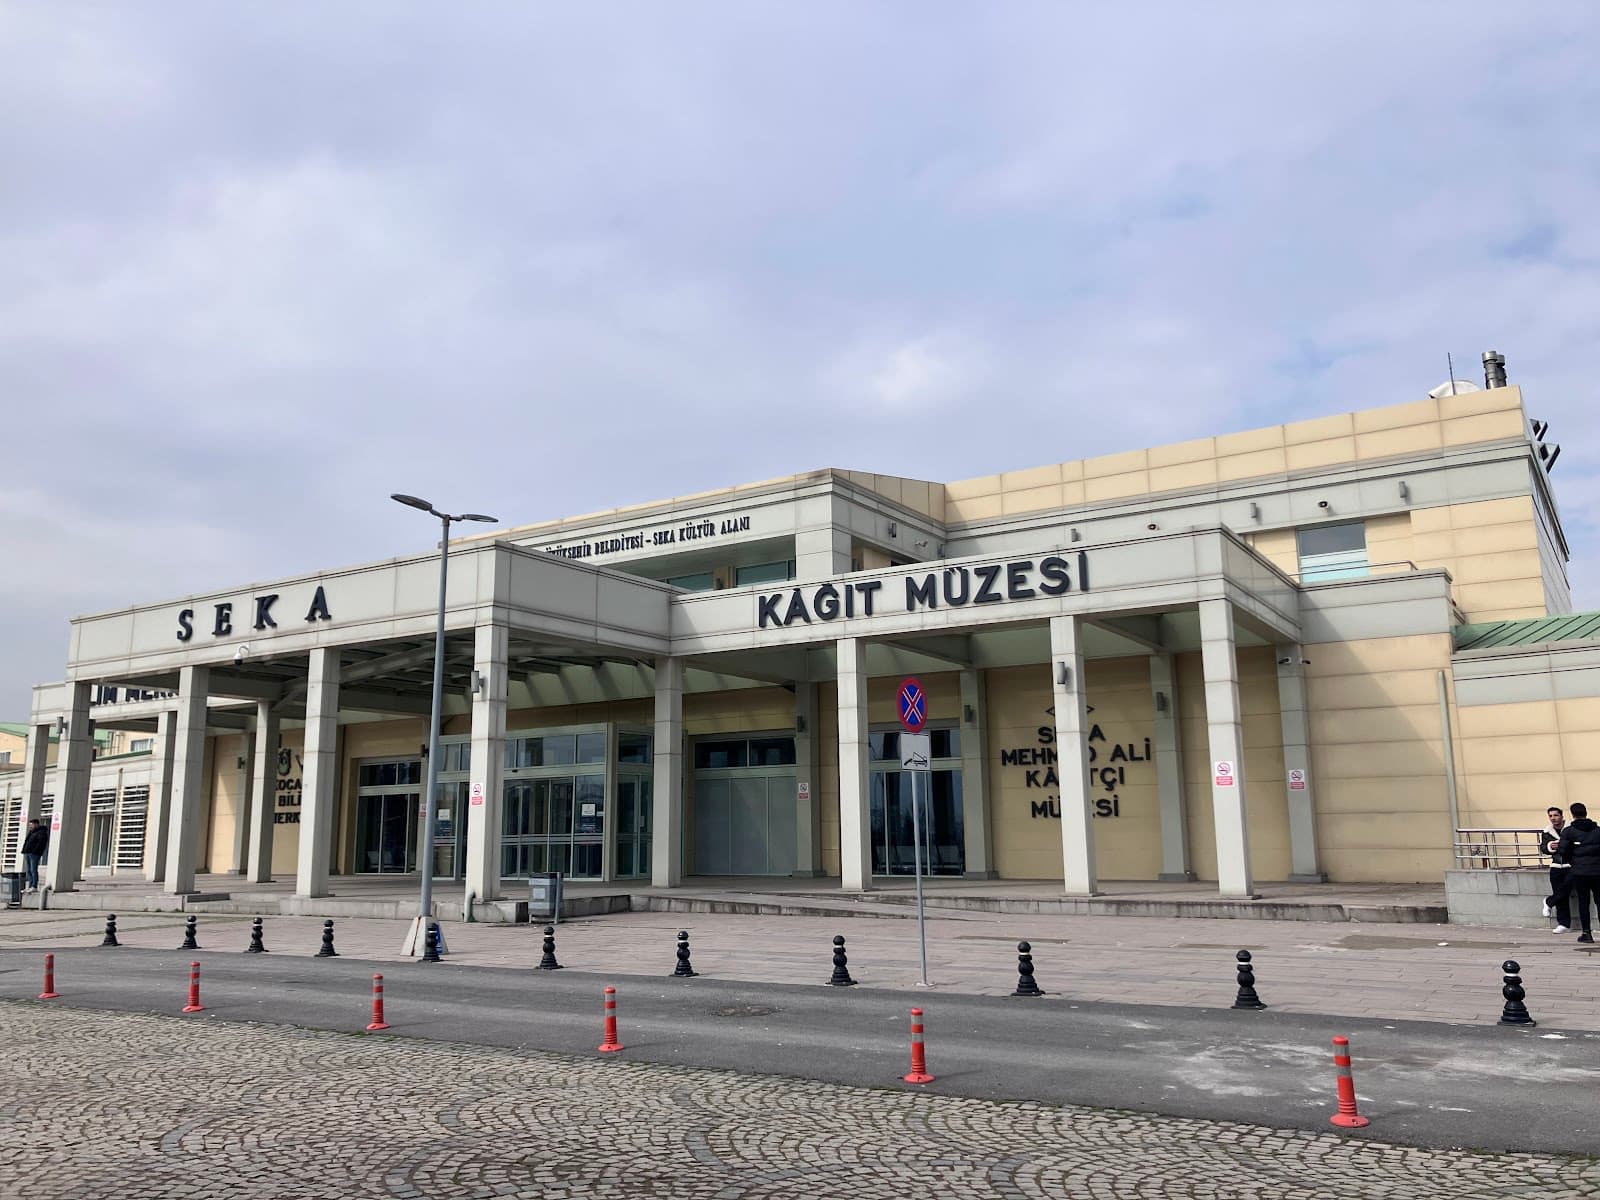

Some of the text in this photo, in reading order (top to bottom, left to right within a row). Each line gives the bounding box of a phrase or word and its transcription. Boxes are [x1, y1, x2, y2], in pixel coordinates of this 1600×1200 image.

[594, 532, 644, 555] BELEDİYESİ
[653, 530, 675, 546] SEKA
[679, 520, 716, 542] KÜLTÜR
[720, 516, 750, 535] ALANI
[905, 550, 1090, 612] MÜZESİ
[176, 585, 332, 641] SEKA
[1038, 724, 1106, 744] SA
[1110, 737, 1151, 762] ALİ
[1025, 766, 1125, 791] KÂTÇI
[1031, 794, 1119, 818] MÜSİ
